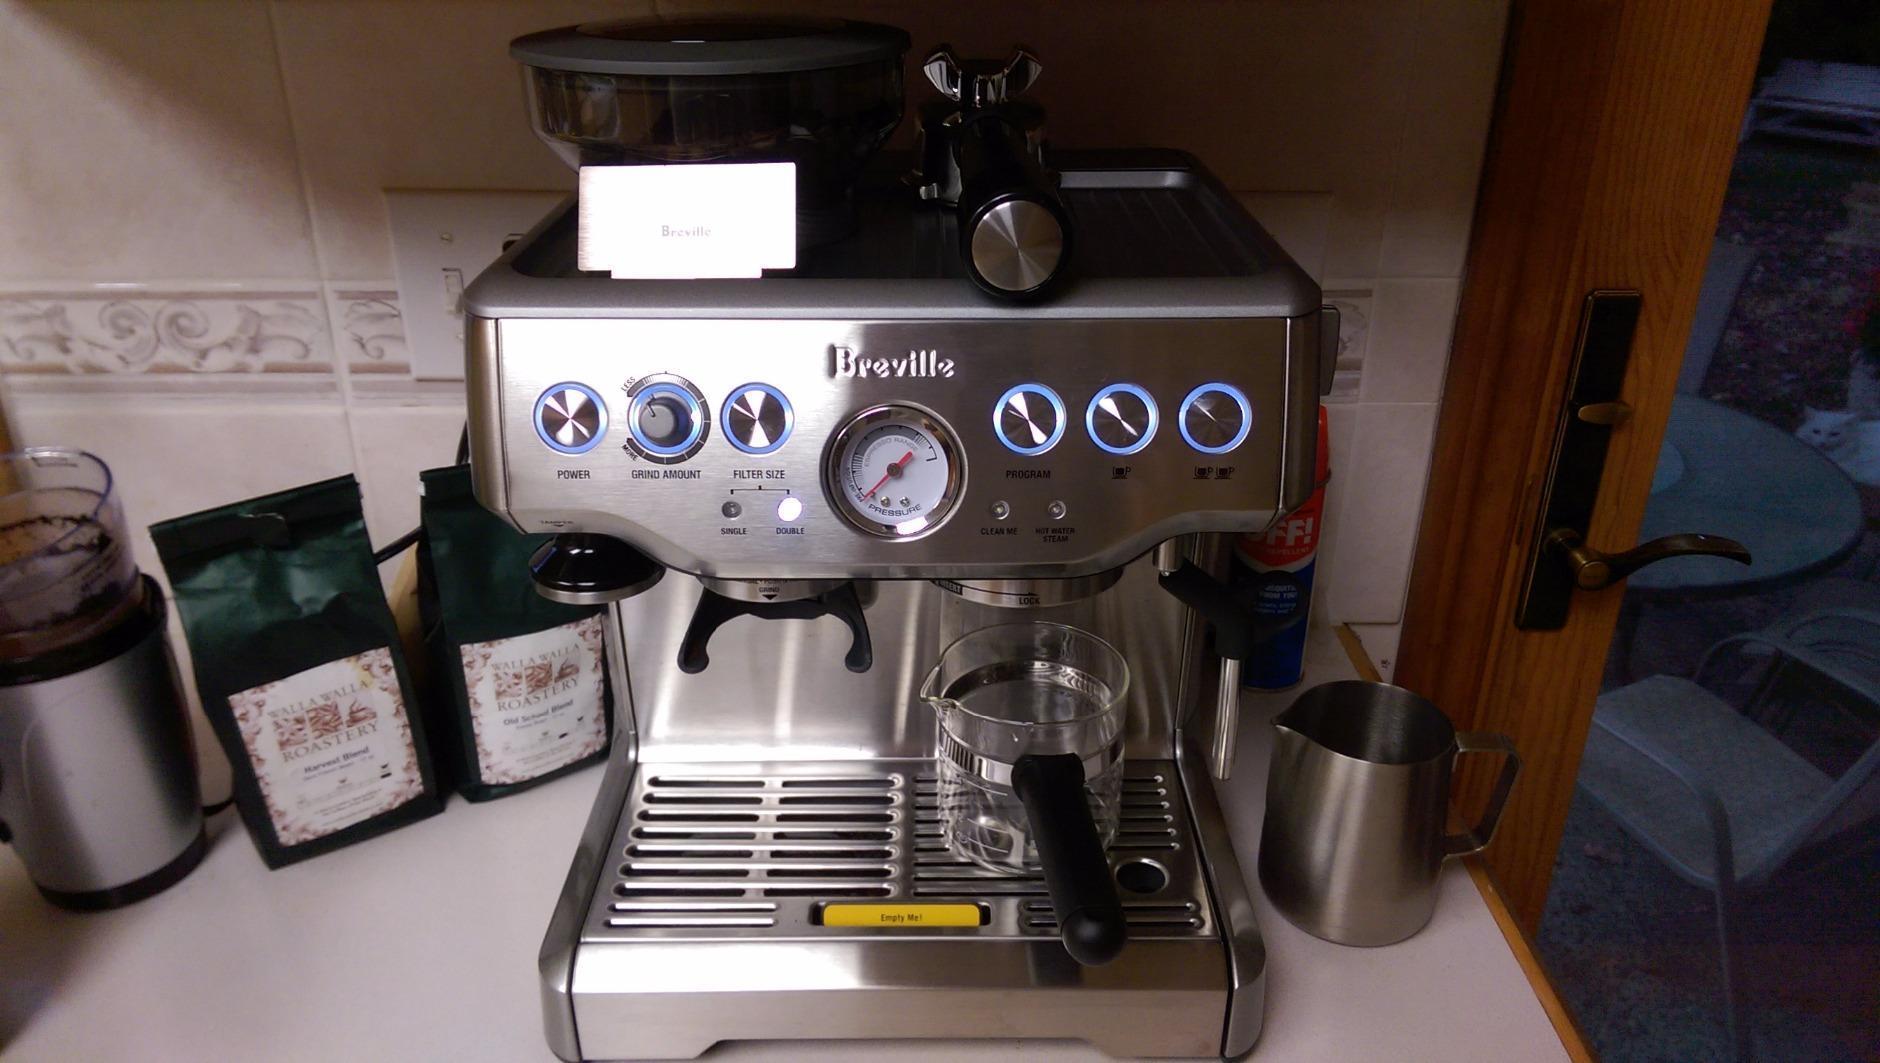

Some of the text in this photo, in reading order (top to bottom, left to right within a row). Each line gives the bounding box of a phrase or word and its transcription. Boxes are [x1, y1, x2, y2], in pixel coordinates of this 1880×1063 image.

[661, 225, 712, 238] Breville
[830, 345, 956, 379] Breville
[621, 376, 637, 393] LESS
[621, 444, 638, 462] MORE
[557, 470, 591, 480] POWER
[631, 470, 702, 480] GRIND AMOUNT
[733, 469, 786, 479] FILTER SIZE
[1005, 469, 1051, 479] PROGRAM
[868, 503, 921, 517] PRESSURE
[720, 527, 748, 535] SINGLE
[775, 527, 805, 535] DOUBLE
[980, 527, 1018, 536] CLEAN ME
[1035, 527, 1076, 535] HOT WATER
[1246, 517, 1314, 546] FF!
[1042, 535, 1069, 543] STEAM
[1018, 597, 1041, 605] LOCK
[492, 643, 580, 672] WALLA WALLA
[267, 681, 369, 719] WALLA WALLA
[497, 678, 578, 712] ROASTERY
[503, 717, 520, 727] Old
[551, 700, 574, 714] Blend
[281, 721, 378, 763] ROASTERY
[304, 756, 340, 774] Harvest
[342, 746, 370, 761] Blend
[880, 913, 922, 923] Empty Me!
